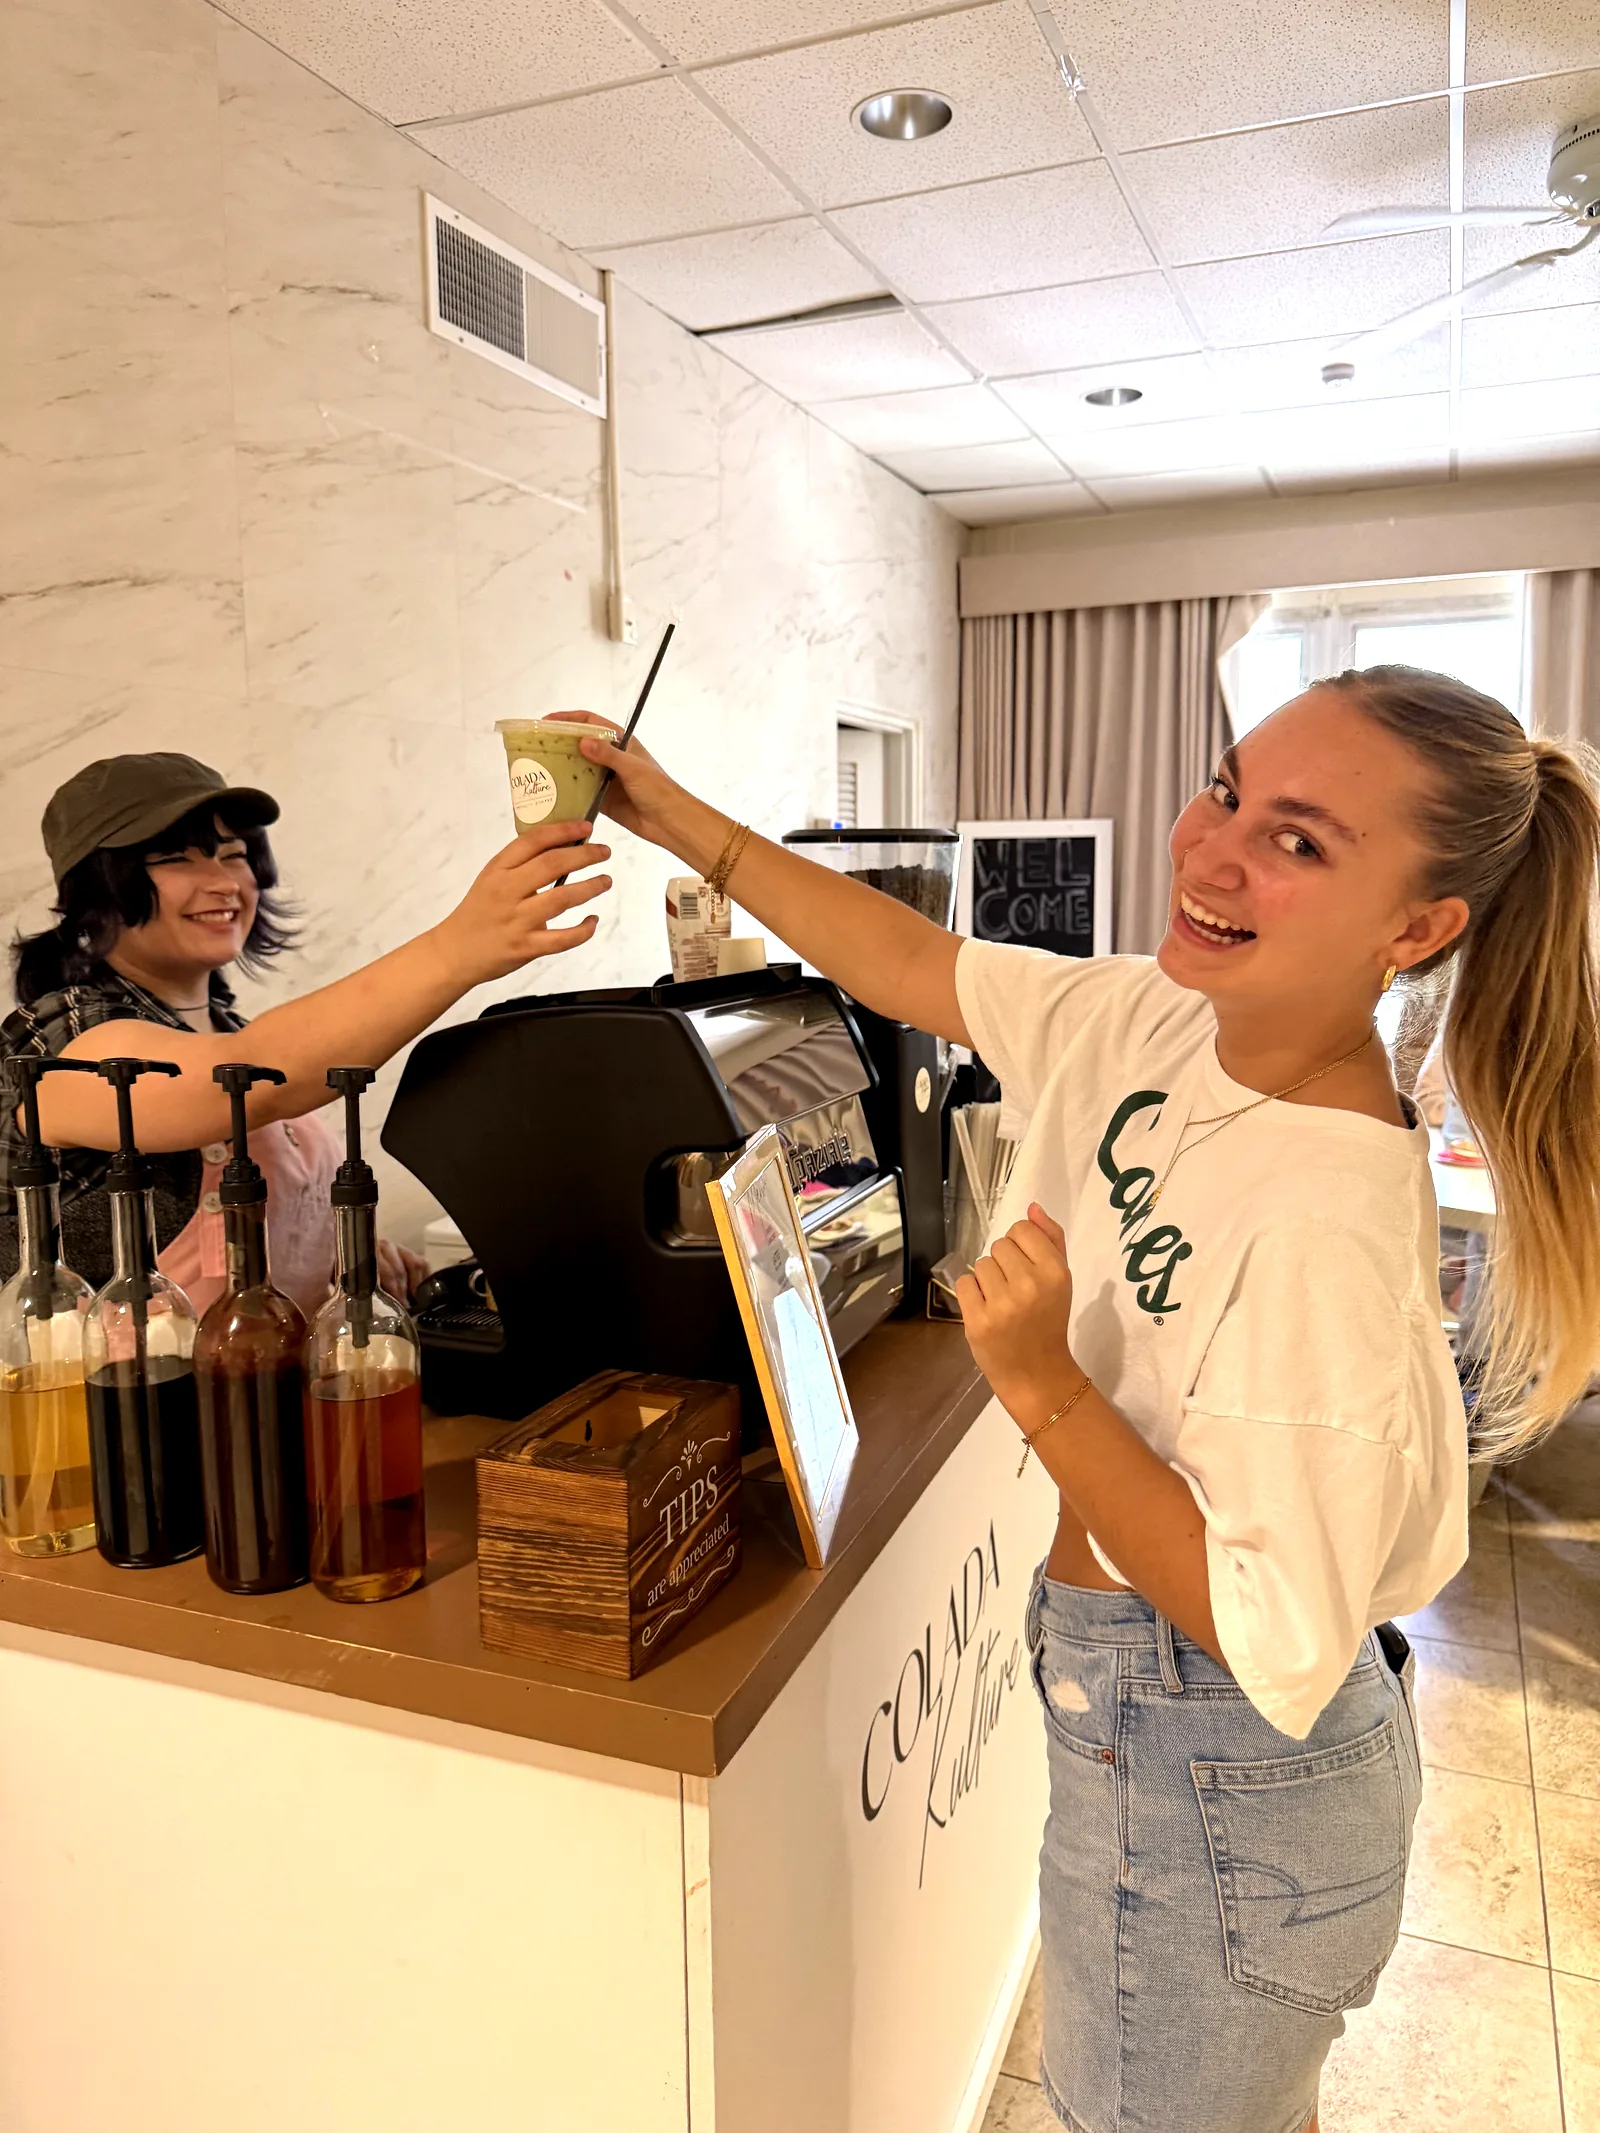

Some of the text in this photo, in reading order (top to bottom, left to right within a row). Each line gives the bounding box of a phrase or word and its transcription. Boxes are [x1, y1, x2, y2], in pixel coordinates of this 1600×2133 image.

[974, 838, 1091, 888] WEL
[975, 885, 1091, 942] COME
[660, 1465, 719, 1548] TIPS
[647, 1513, 730, 1607] are appreciated
[862, 1518, 1000, 1822] COLADA
[918, 1627, 1023, 1890] Kulture
